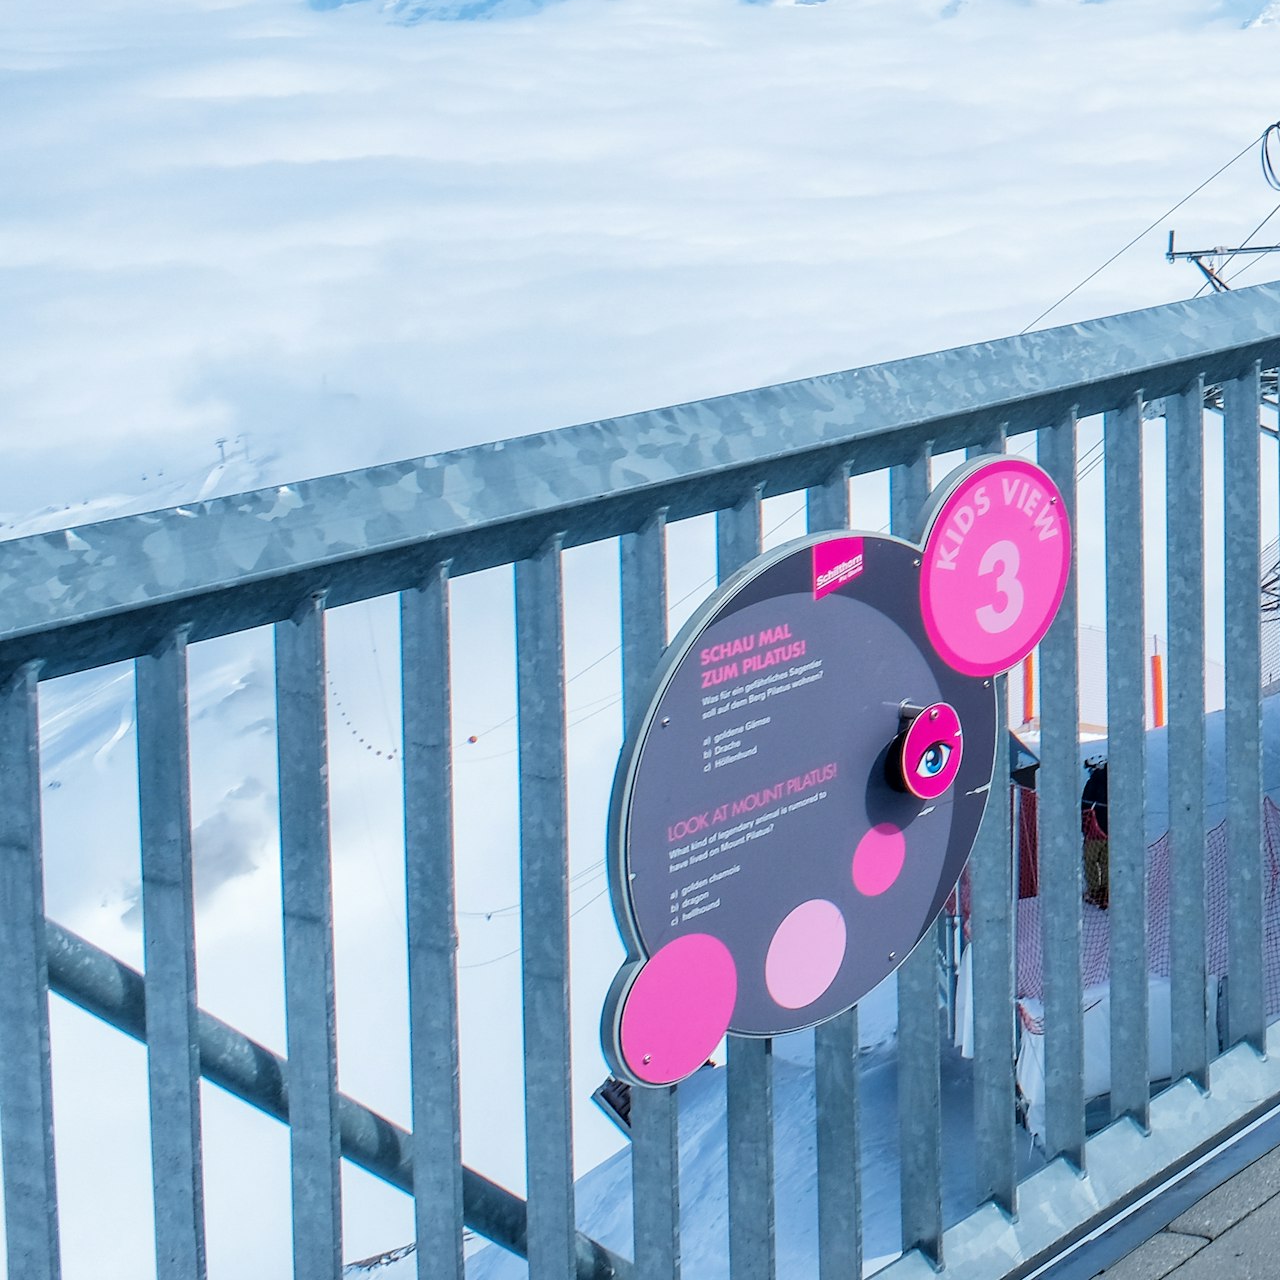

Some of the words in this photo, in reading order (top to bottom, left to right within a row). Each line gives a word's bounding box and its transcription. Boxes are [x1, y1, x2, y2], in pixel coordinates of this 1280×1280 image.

[936, 486, 991, 570] KIDS
[1002, 478, 1058, 541] VIEW
[816, 554, 863, 586] Schilthorn
[975, 539, 1025, 634] 3
[701, 634, 755, 665] SCHAU
[758, 623, 792, 647] MAL
[701, 663, 738, 689] ZUM
[743, 640, 806, 674] PILATUS!
[702, 707, 716, 720] soll
[717, 703, 730, 714] auf
[730, 697, 748, 710] dem
[748, 690, 766, 705] Berg
[766, 683, 791, 698] Pilatus
[791, 670, 824, 689] wohnen?
[702, 694, 719, 706] Was
[720, 689, 732, 700] für
[732, 685, 744, 696] ein
[703, 735, 711, 746] a)
[713, 725, 745, 743] goldene
[703, 748, 711, 759] b)
[714, 740, 741, 755] Drache
[703, 762, 711, 772] c)
[714, 745, 758, 769] Höllenhund
[667, 812, 709, 842] LOOK
[711, 803, 729, 825] AT
[731, 782, 785, 817] MOUNT
[786, 763, 838, 795] PILATUS!
[668, 845, 690, 859] What
[690, 837, 707, 851] kind
[708, 834, 718, 844] of
[717, 820, 755, 842] legendary
[755, 808, 780, 824] animal
[781, 806, 788, 815] is
[788, 793, 819, 812] rumored
[819, 791, 827, 800] to
[669, 859, 689, 873] have
[689, 850, 709, 865] lived
[709, 846, 720, 856] on
[720, 836, 746, 852] Mount
[746, 823, 775, 842] Pilatus?
[670, 889, 678, 900] a)
[681, 878, 708, 897] golden
[709, 864, 741, 883] chamois
[670, 903, 679, 914] b)
[681, 890, 710, 908] dragon
[670, 916, 679, 926] c)
[682, 898, 721, 921] hellhound
